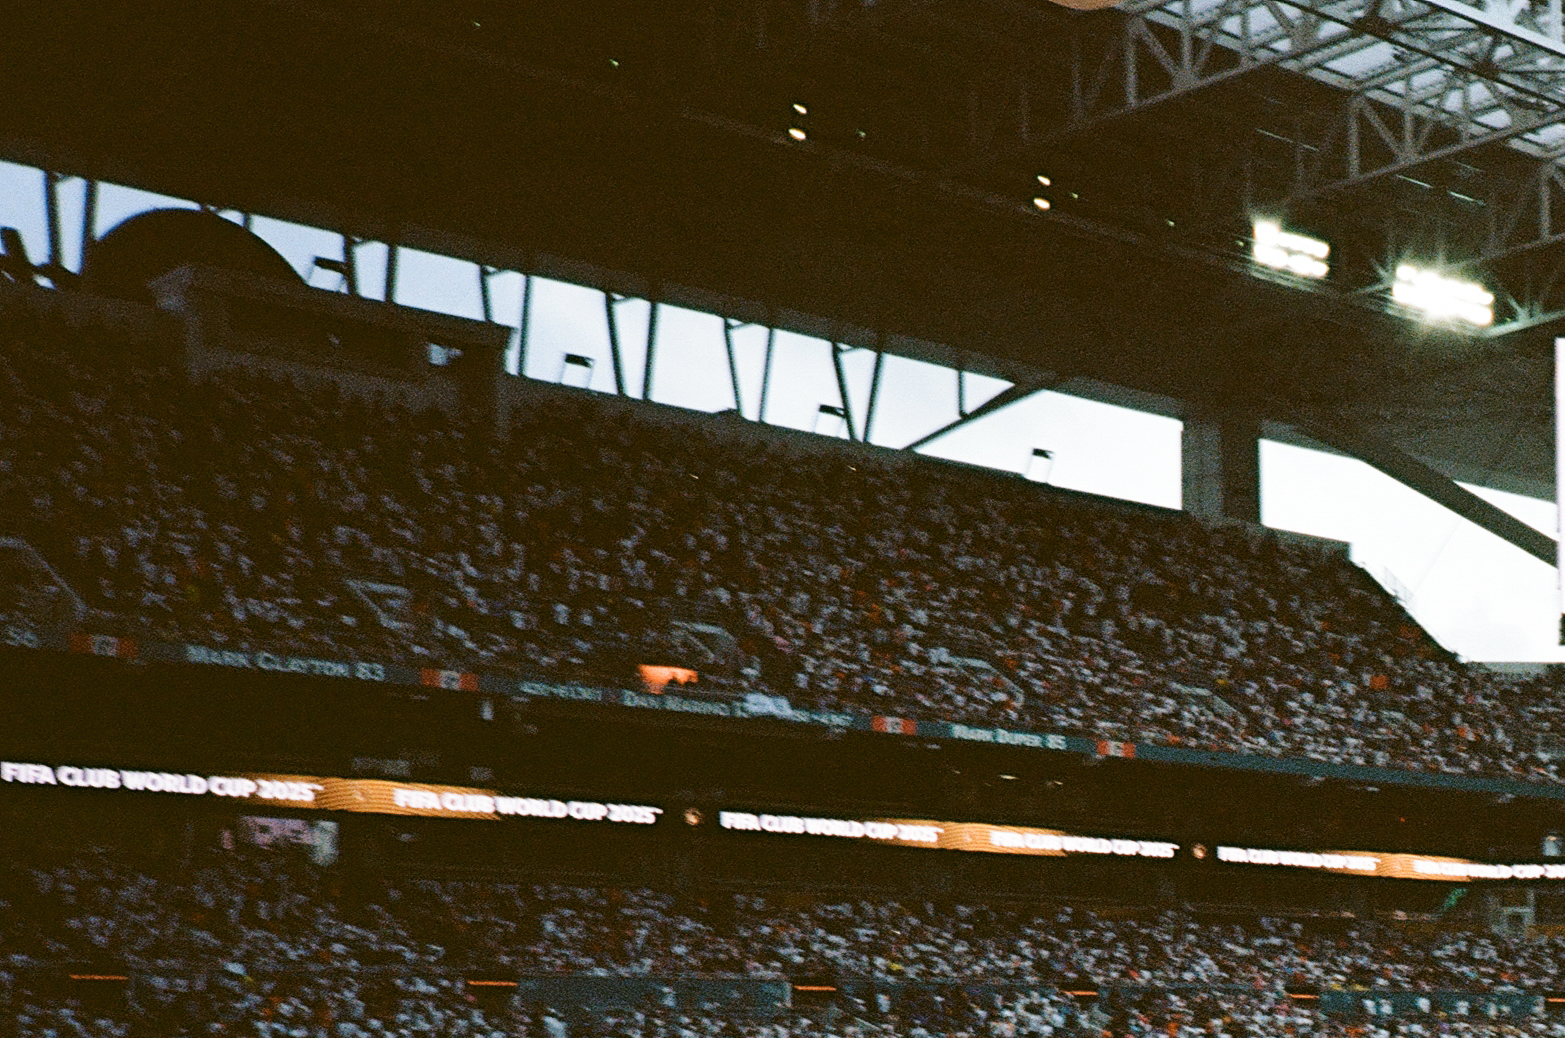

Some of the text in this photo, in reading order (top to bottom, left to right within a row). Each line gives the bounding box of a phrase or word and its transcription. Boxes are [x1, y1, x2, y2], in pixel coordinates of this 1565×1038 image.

[1, 762, 56, 784] FIFA
[57, 766, 121, 789] CLUB
[121, 771, 208, 794] WORLD
[209, 776, 257, 797] CUP
